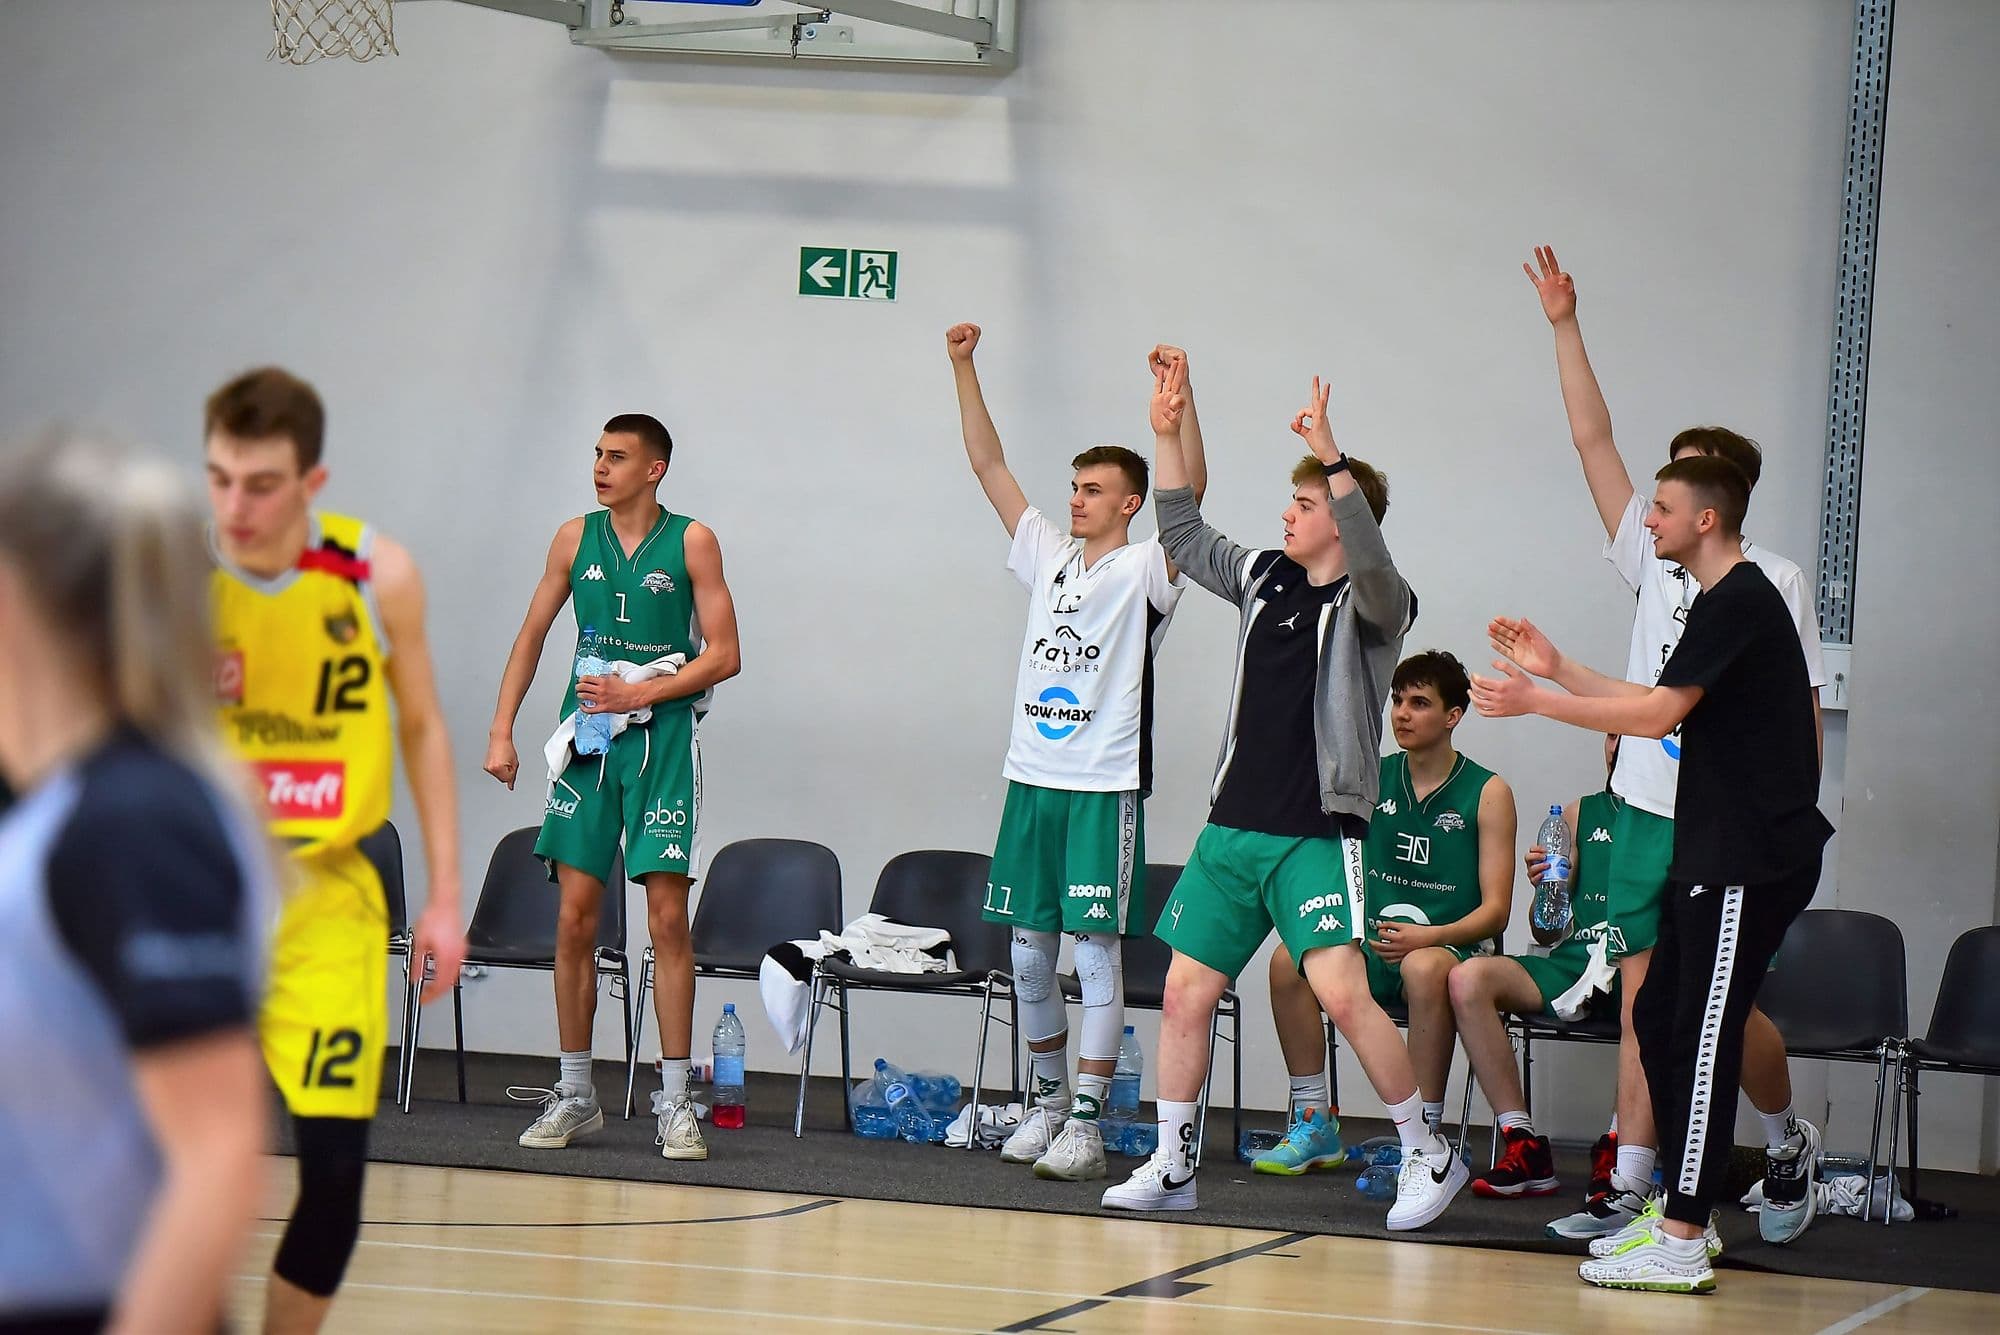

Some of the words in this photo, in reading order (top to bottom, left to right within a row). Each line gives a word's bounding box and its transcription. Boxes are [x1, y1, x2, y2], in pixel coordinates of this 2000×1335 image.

[615, 592, 631, 623] 1
[314, 655, 370, 715] 12
[268, 771, 341, 810] Trefl
[643, 797, 686, 837] pbo
[1123, 802, 1134, 860] ZIELONA
[1396, 832, 1430, 865] 30
[983, 882, 1014, 915] 11
[1068, 885, 1111, 898] zoom
[1381, 872, 1408, 886] fatto
[1411, 879, 1456, 892] deweloper
[1171, 899, 1184, 931] 4
[1299, 892, 1343, 919] zoom
[302, 1026, 363, 1089] 12
